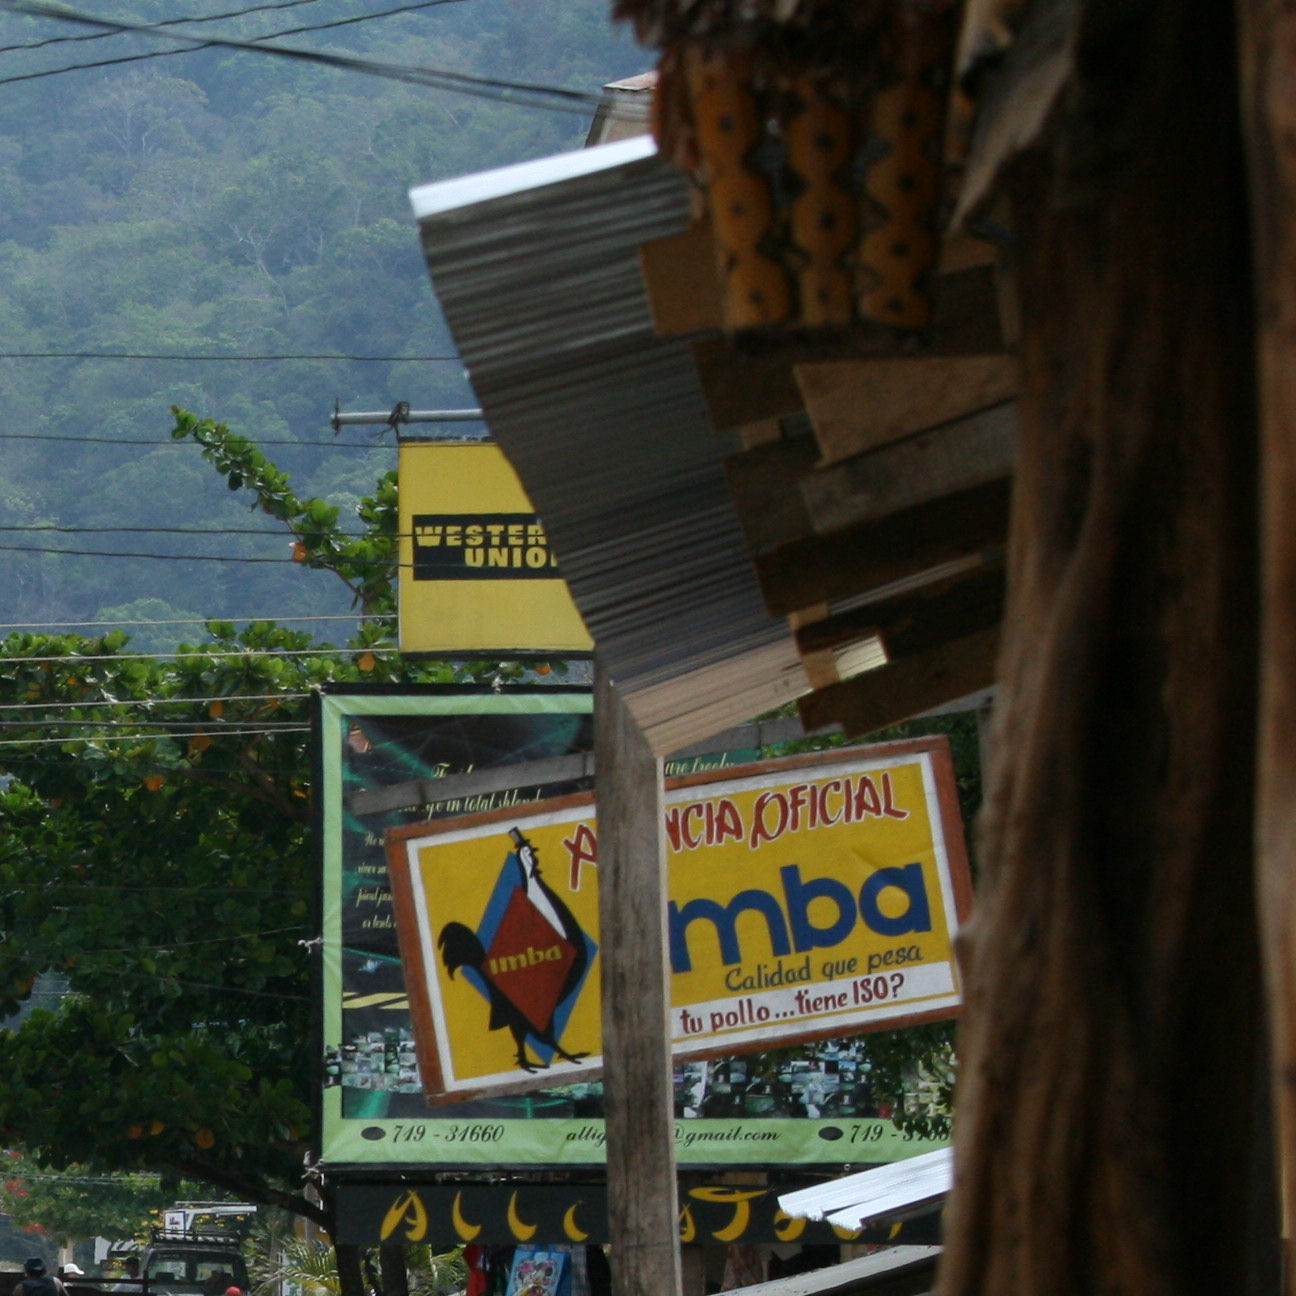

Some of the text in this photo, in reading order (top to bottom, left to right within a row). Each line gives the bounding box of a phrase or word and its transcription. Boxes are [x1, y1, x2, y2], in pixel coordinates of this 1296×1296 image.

[415, 525, 547, 547] WESTER
[749, 772, 909, 849] OFICIAL
[668, 862, 933, 973] mba
[725, 944, 924, 991] Calidad que pesa
[680, 1008, 703, 1034] tu
[853, 972, 905, 1005] ISO?
